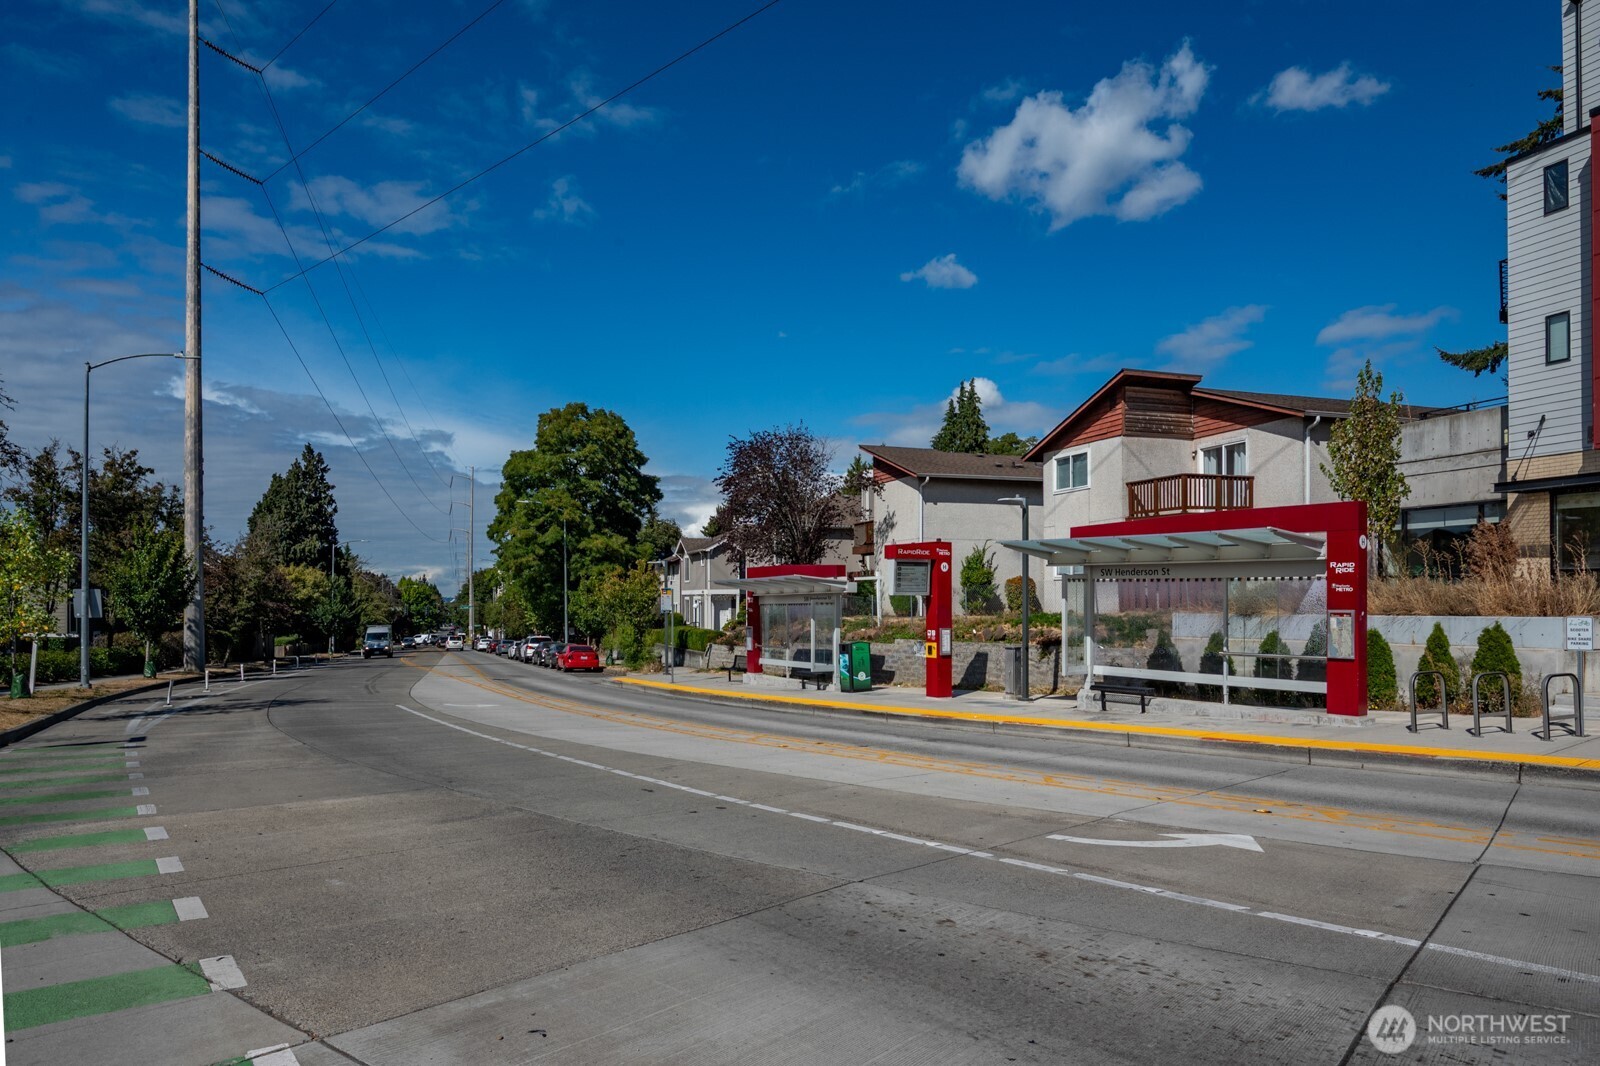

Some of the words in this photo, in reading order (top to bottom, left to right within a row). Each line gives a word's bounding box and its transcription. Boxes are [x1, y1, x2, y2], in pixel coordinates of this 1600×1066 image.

[1100, 568, 1113, 576] SW
[1115, 568, 1159, 576] Henderson
[1161, 567, 1170, 576] St
